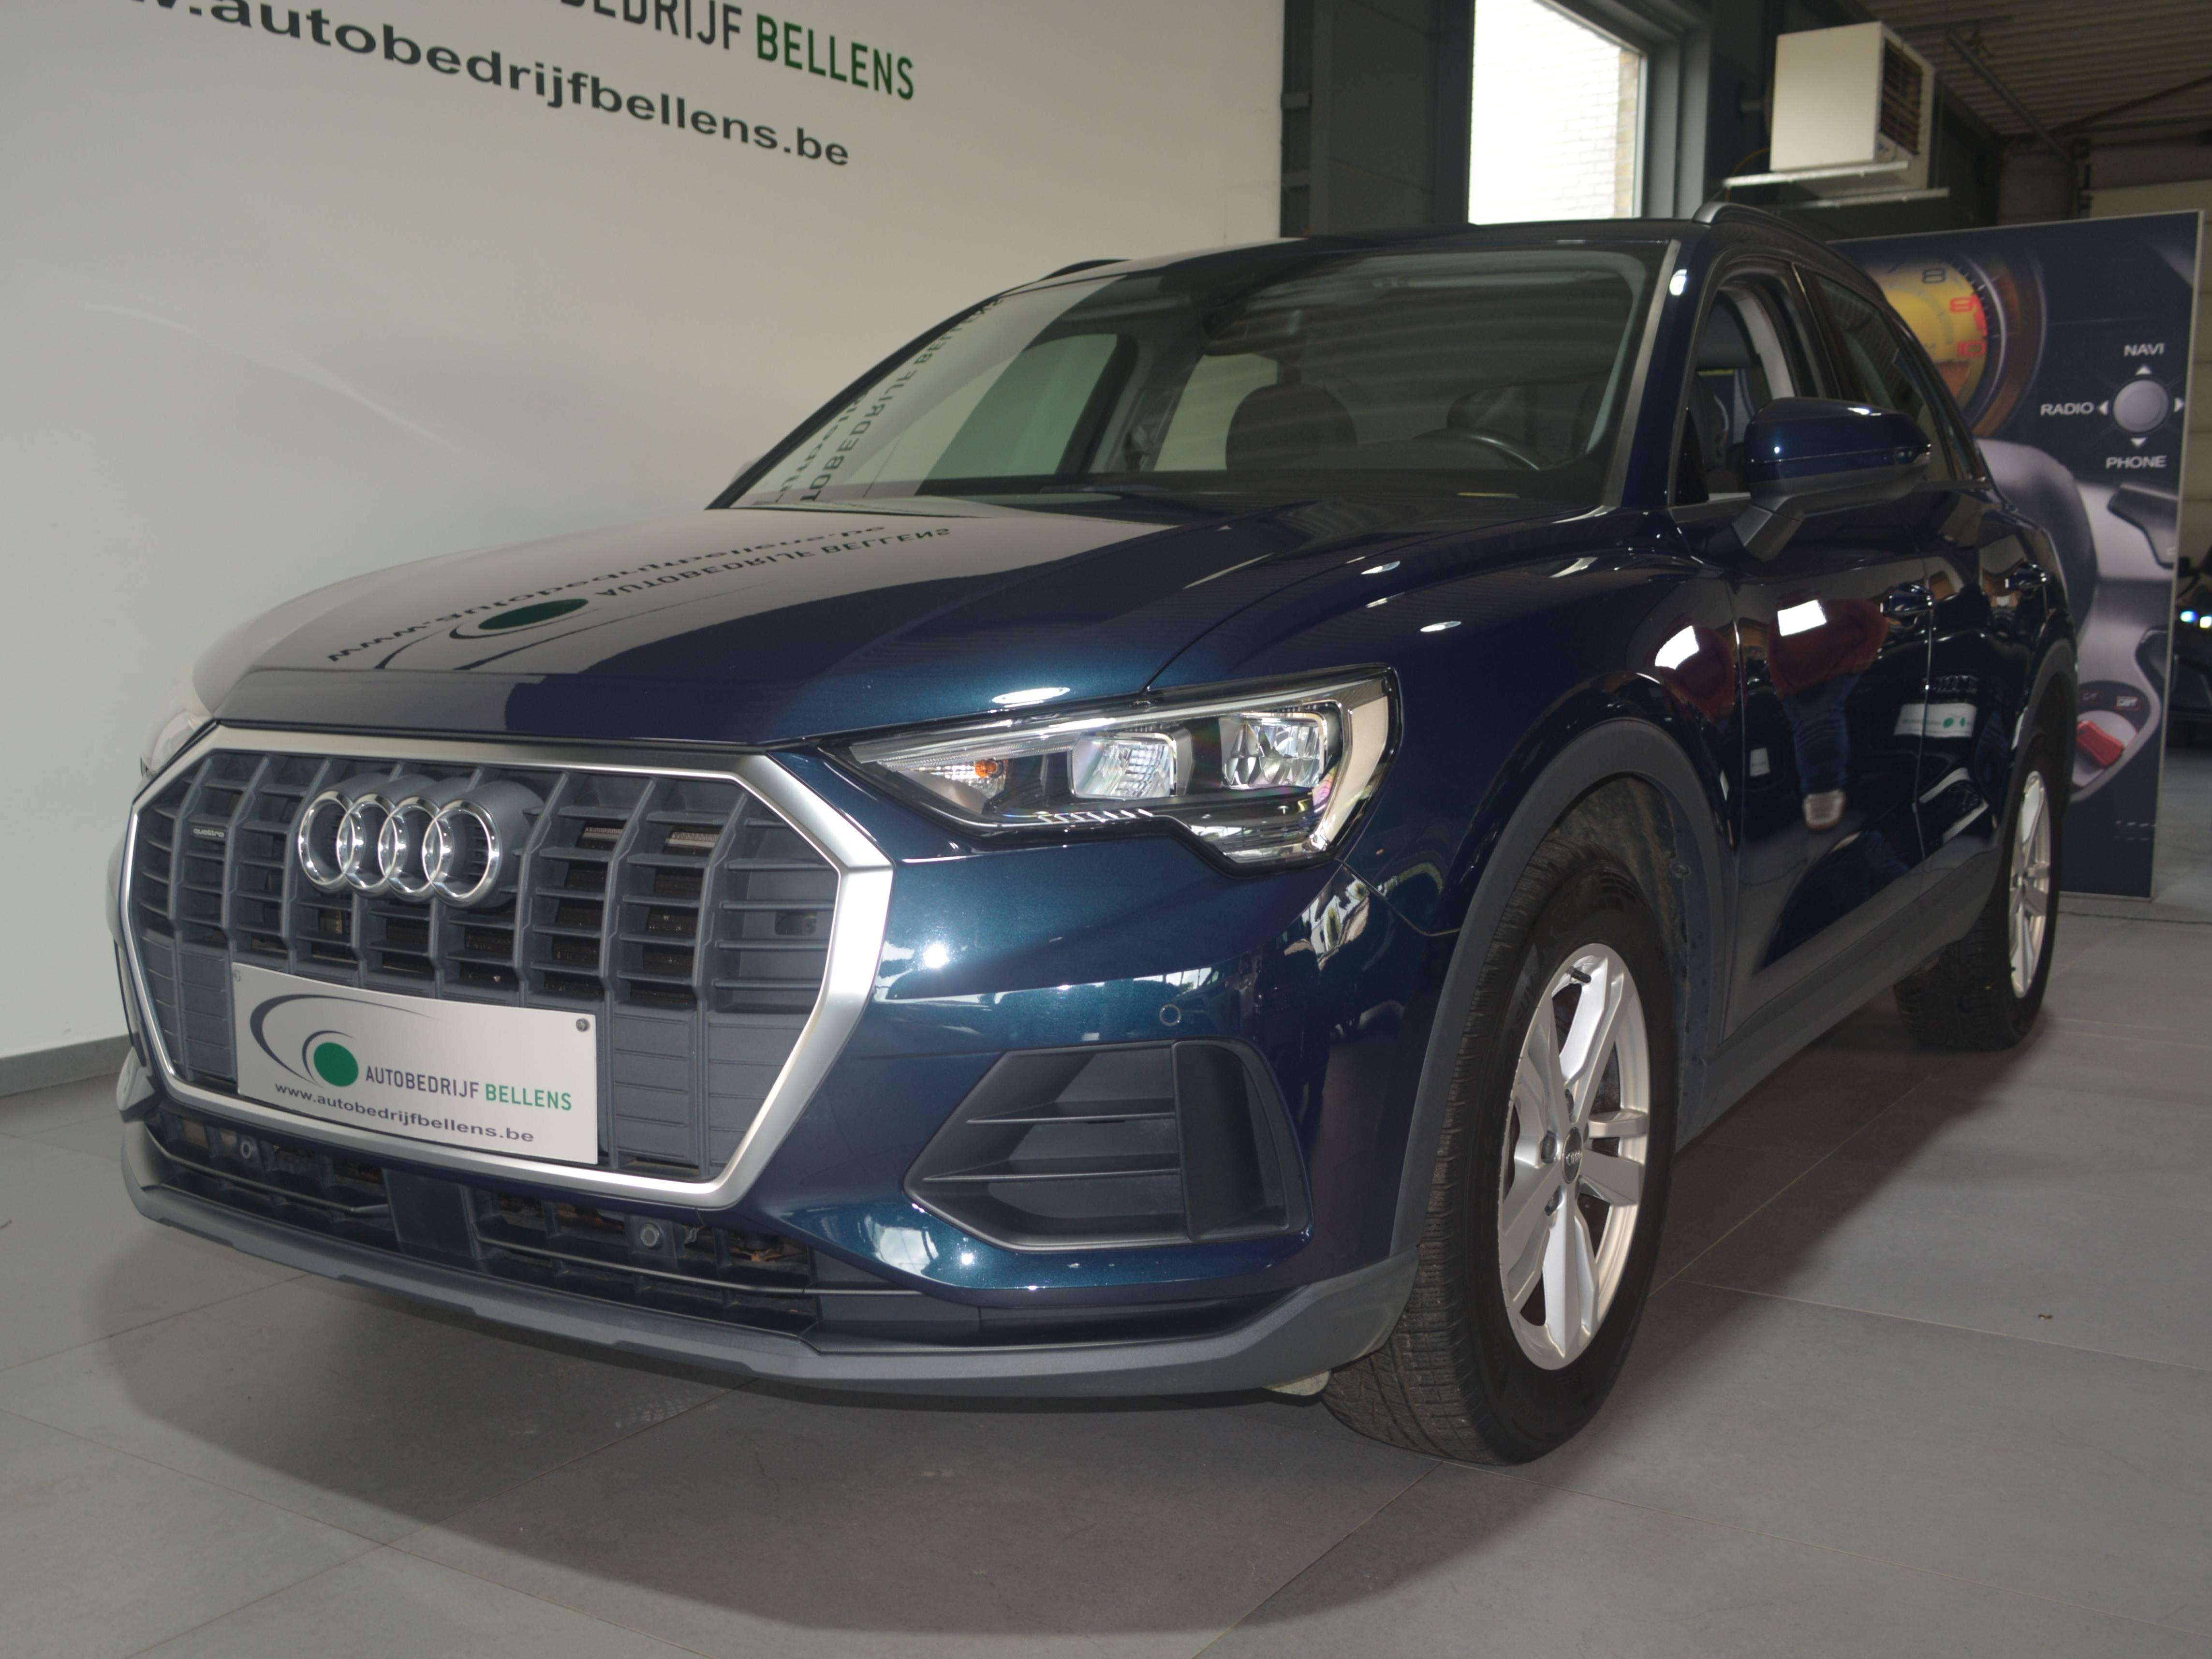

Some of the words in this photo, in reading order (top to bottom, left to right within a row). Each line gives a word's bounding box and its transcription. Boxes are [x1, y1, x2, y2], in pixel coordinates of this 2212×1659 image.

[756, 13, 914, 101] BELLENS
[2124, 342, 2165, 357] NAVI
[2040, 401, 2094, 416] RADIO
[2106, 455, 2168, 469] PHONE
[193, 828, 224, 838] quattro
[366, 1065, 480, 1099] AUTOBEDRIJF
[485, 1085, 572, 1111] BELLENS
[275, 1083, 534, 1143] www.autobedrijfbellens.be
